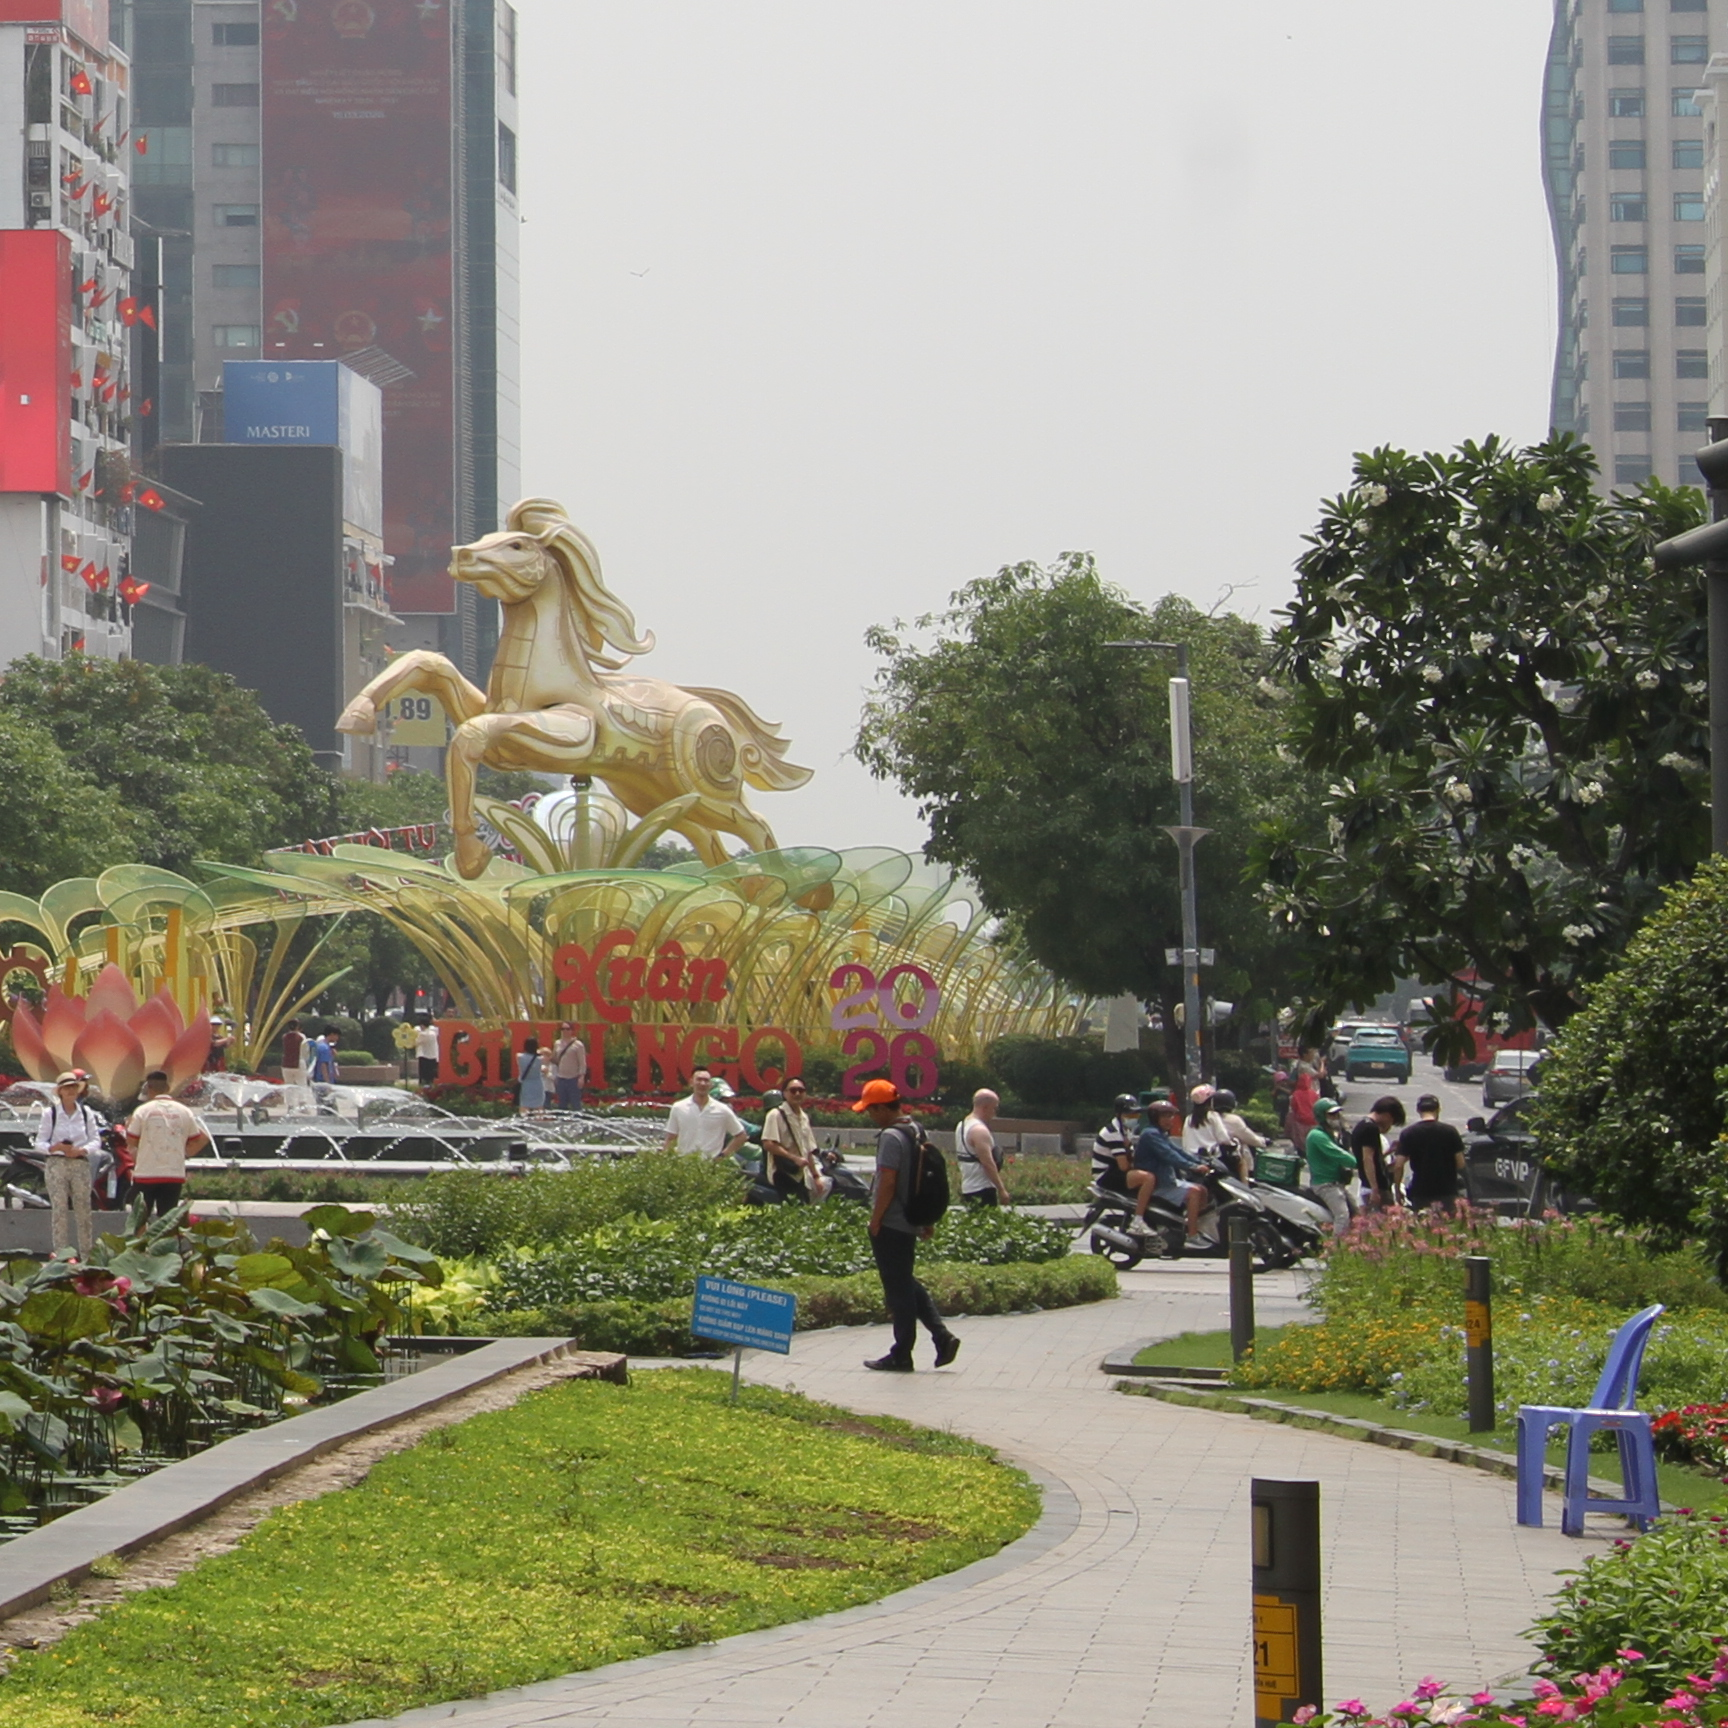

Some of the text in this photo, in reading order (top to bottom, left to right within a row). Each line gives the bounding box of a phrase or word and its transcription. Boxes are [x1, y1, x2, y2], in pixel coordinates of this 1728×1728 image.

[247, 425, 310, 439] MASTERI
[552, 928, 729, 1024] Xuân
[830, 963, 941, 1030] 20
[844, 1031, 939, 1099] 26
